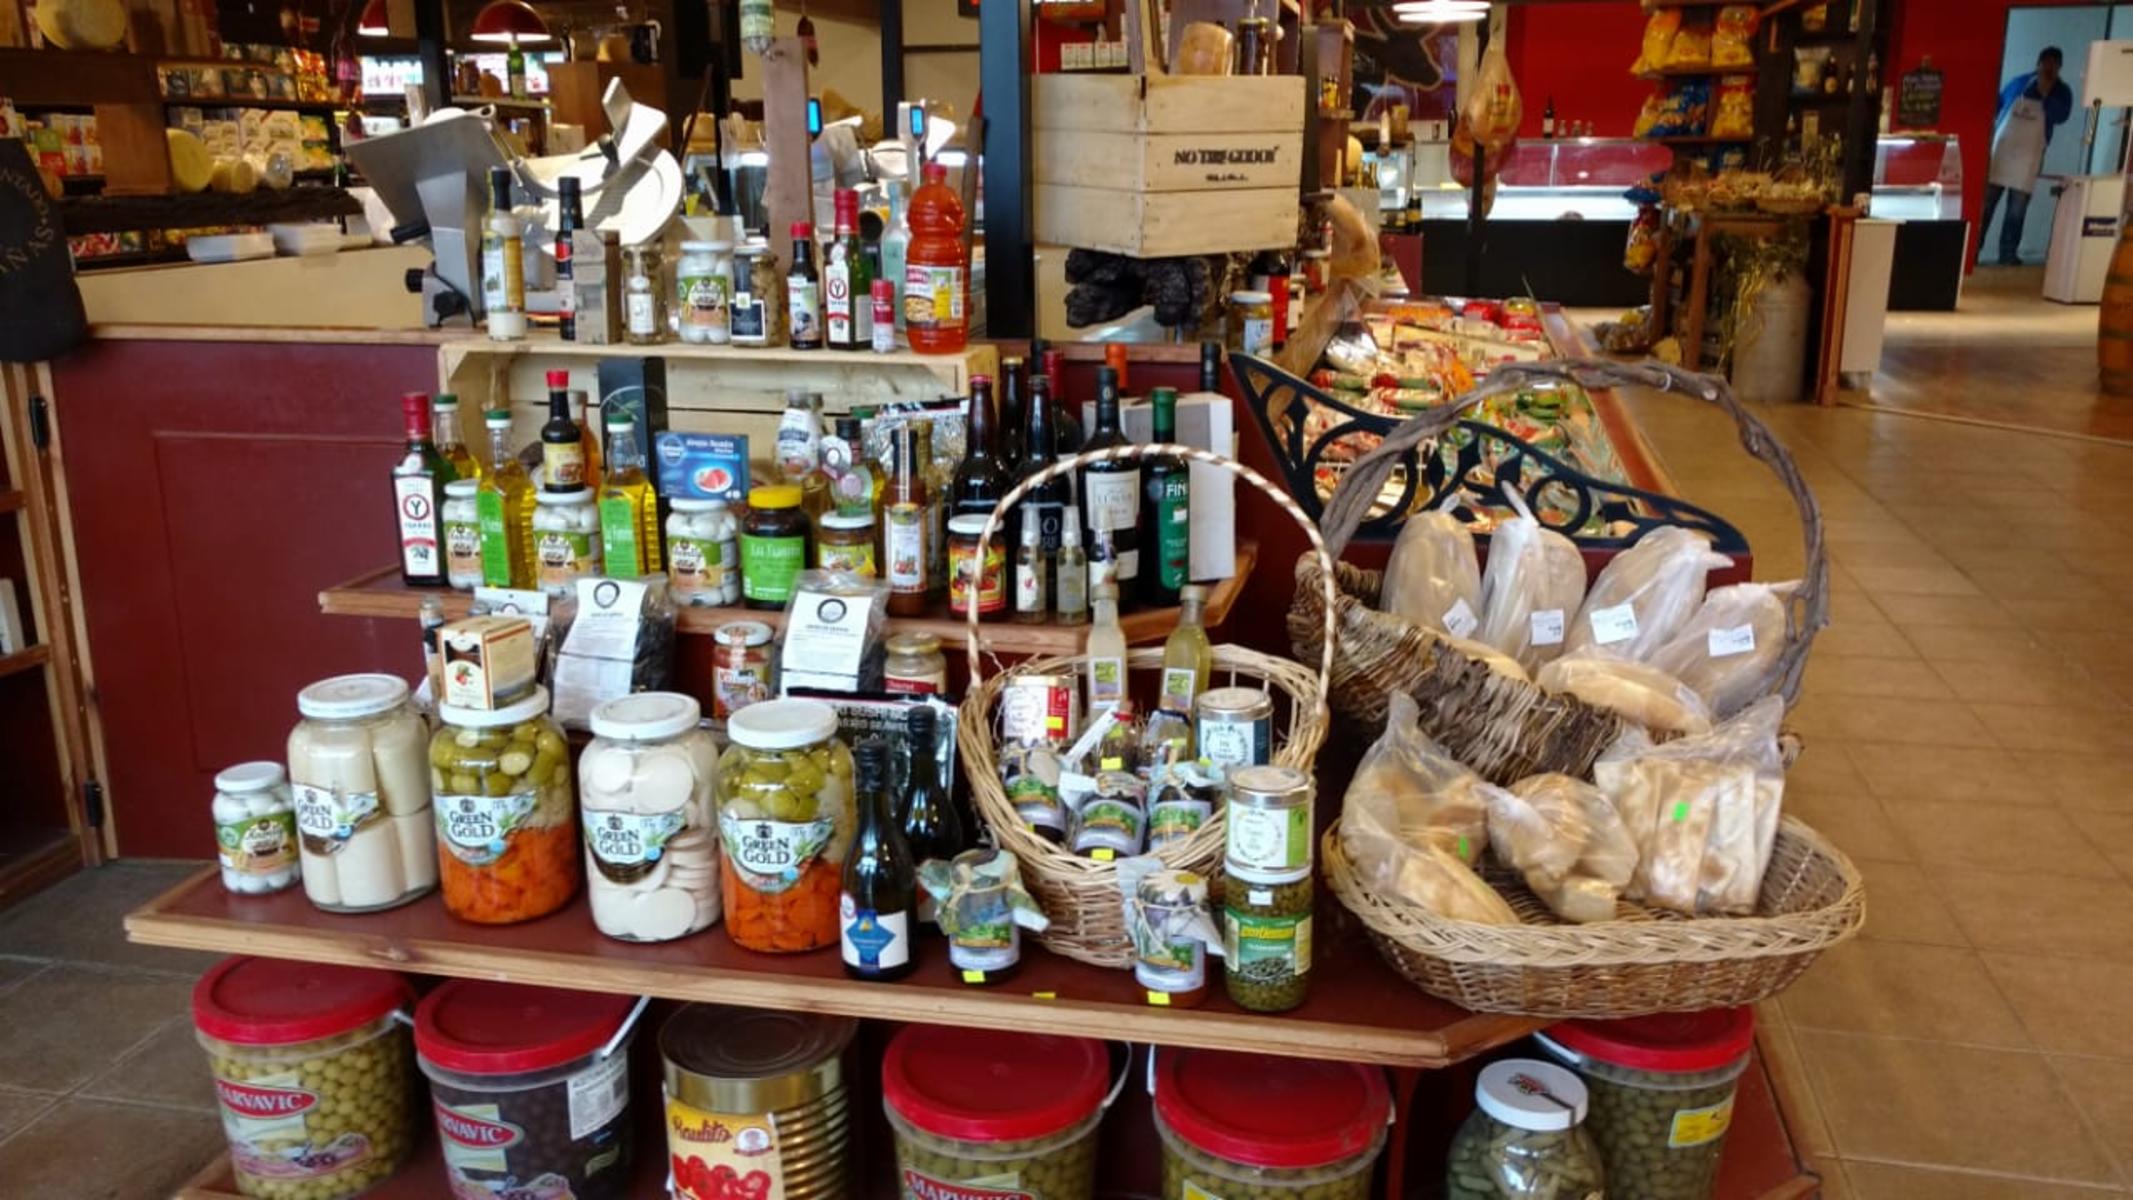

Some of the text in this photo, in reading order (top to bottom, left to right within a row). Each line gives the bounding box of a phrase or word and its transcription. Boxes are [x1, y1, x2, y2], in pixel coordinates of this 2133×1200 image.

[449, 811, 493, 824] GREEN
[451, 823, 495, 838] GOLD
[597, 826, 640, 841] GREEN
[600, 840, 642, 856] GOLD
[742, 835, 790, 851] GREEN
[743, 847, 791, 865] GOLD
